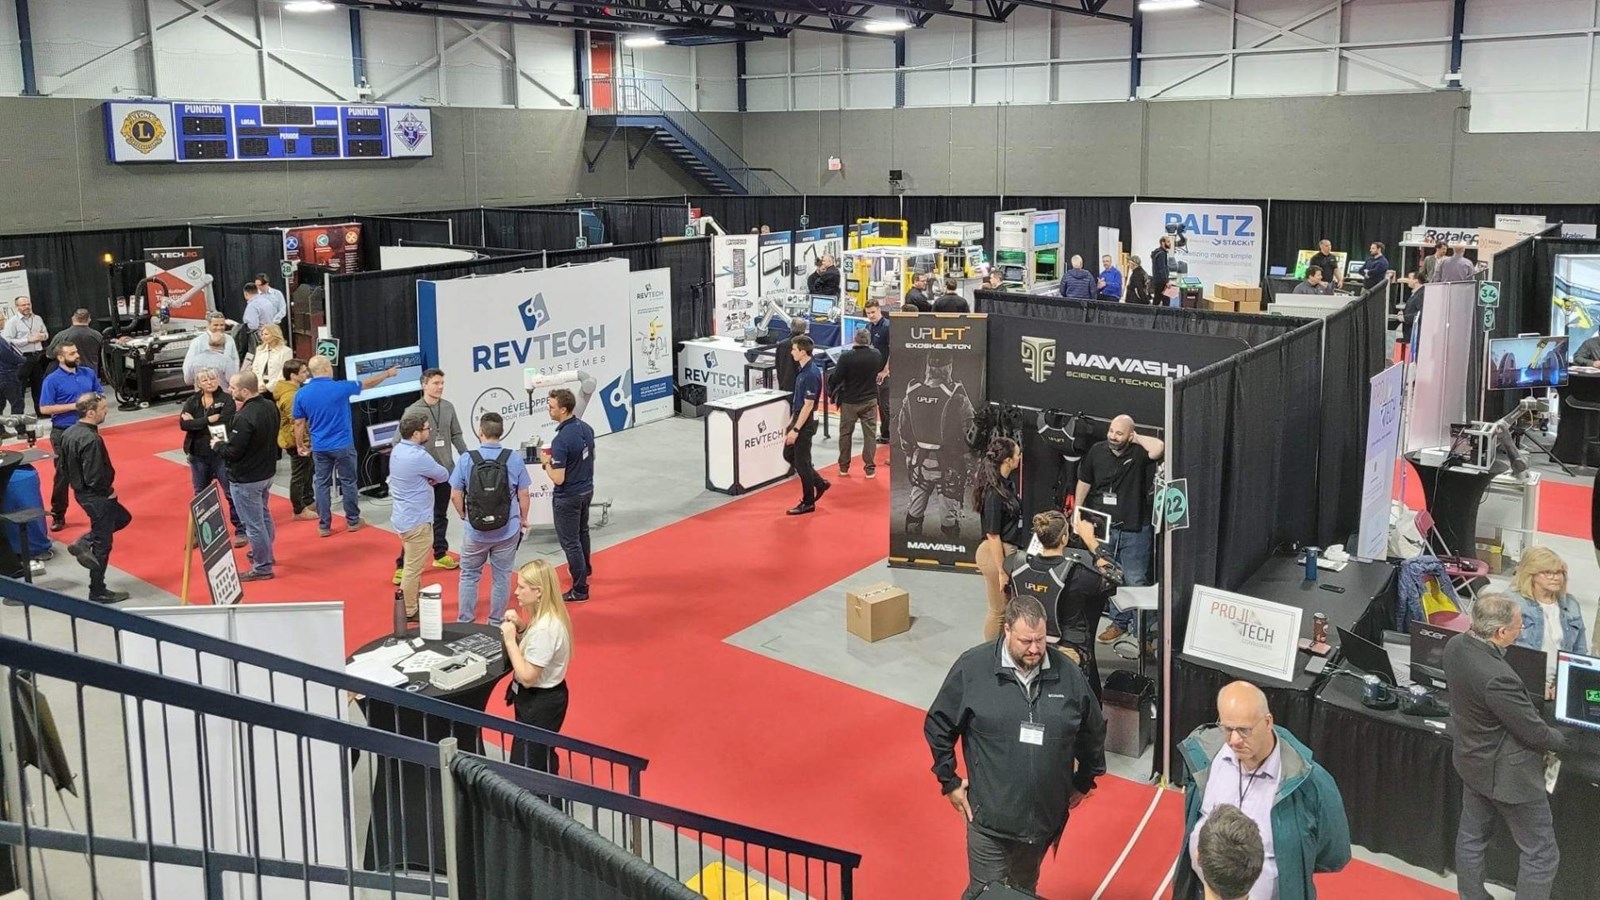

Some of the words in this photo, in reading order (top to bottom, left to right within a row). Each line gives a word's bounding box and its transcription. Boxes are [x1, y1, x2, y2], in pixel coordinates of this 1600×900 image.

[184, 104, 223, 114] PUNITION
[347, 107, 379, 116] PUNITION
[637, 290, 664, 299] REVTECH
[1481, 288, 1497, 299] 34
[319, 345, 336, 357] 25
[472, 324, 606, 373] REVTECH
[904, 342, 971, 350] EXOSKELETON
[1066, 370, 1107, 382] SCIENCE
[1108, 375, 1117, 383] &
[917, 396, 939, 404] UPLIFT
[744, 429, 784, 449] REVTECH
[907, 541, 966, 553] MAWASHI
[1024, 582, 1048, 593] UPLIFT
[1210, 601, 1250, 623] PROJI
[1240, 621, 1275, 644] TECH
[1419, 629, 1447, 641] acer
